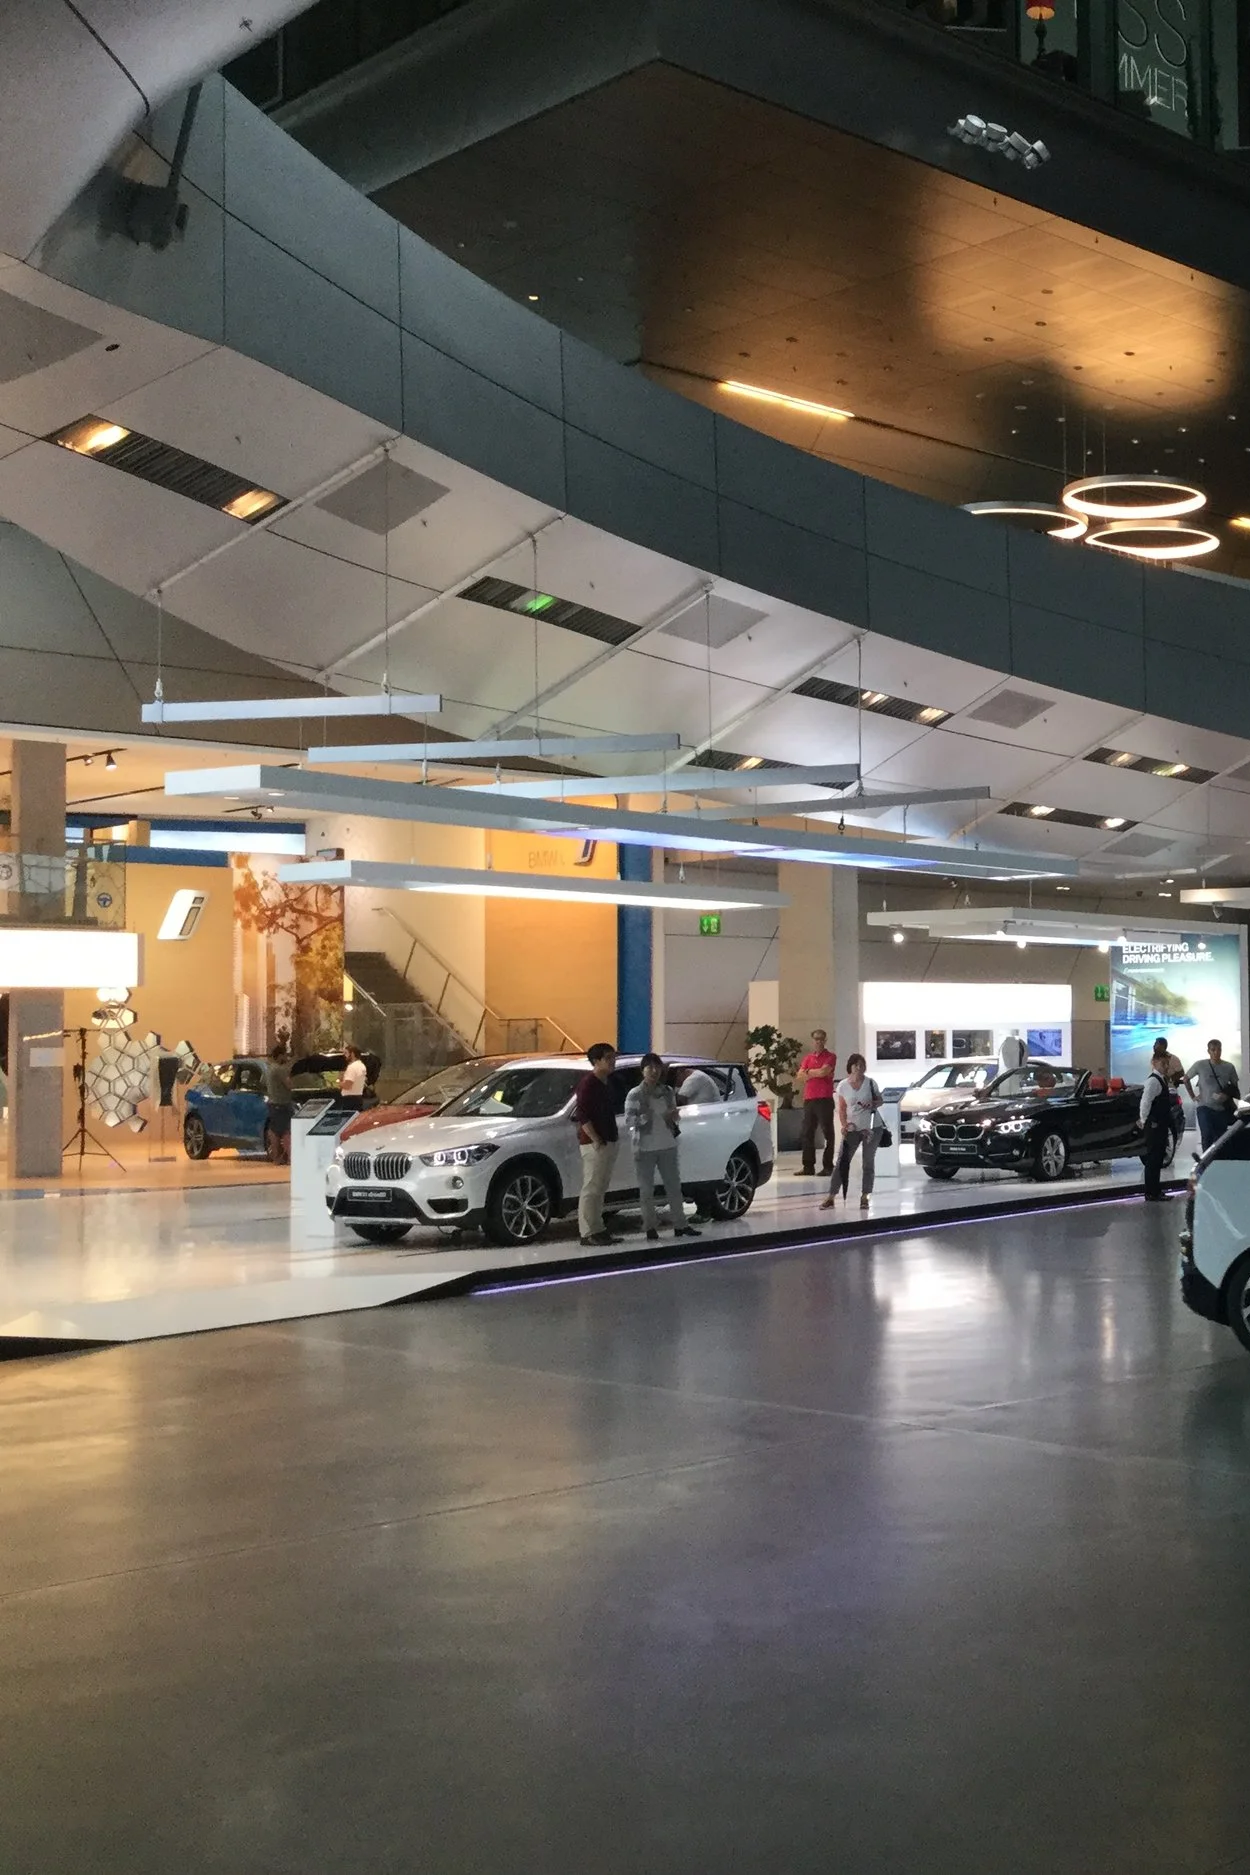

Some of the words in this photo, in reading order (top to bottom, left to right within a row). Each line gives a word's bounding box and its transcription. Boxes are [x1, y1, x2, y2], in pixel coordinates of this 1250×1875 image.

[1122, 942, 1189, 954] ELECTRIFYING
[1122, 953, 1160, 964] DRIVING
[1162, 951, 1215, 963] PLEASURE.
